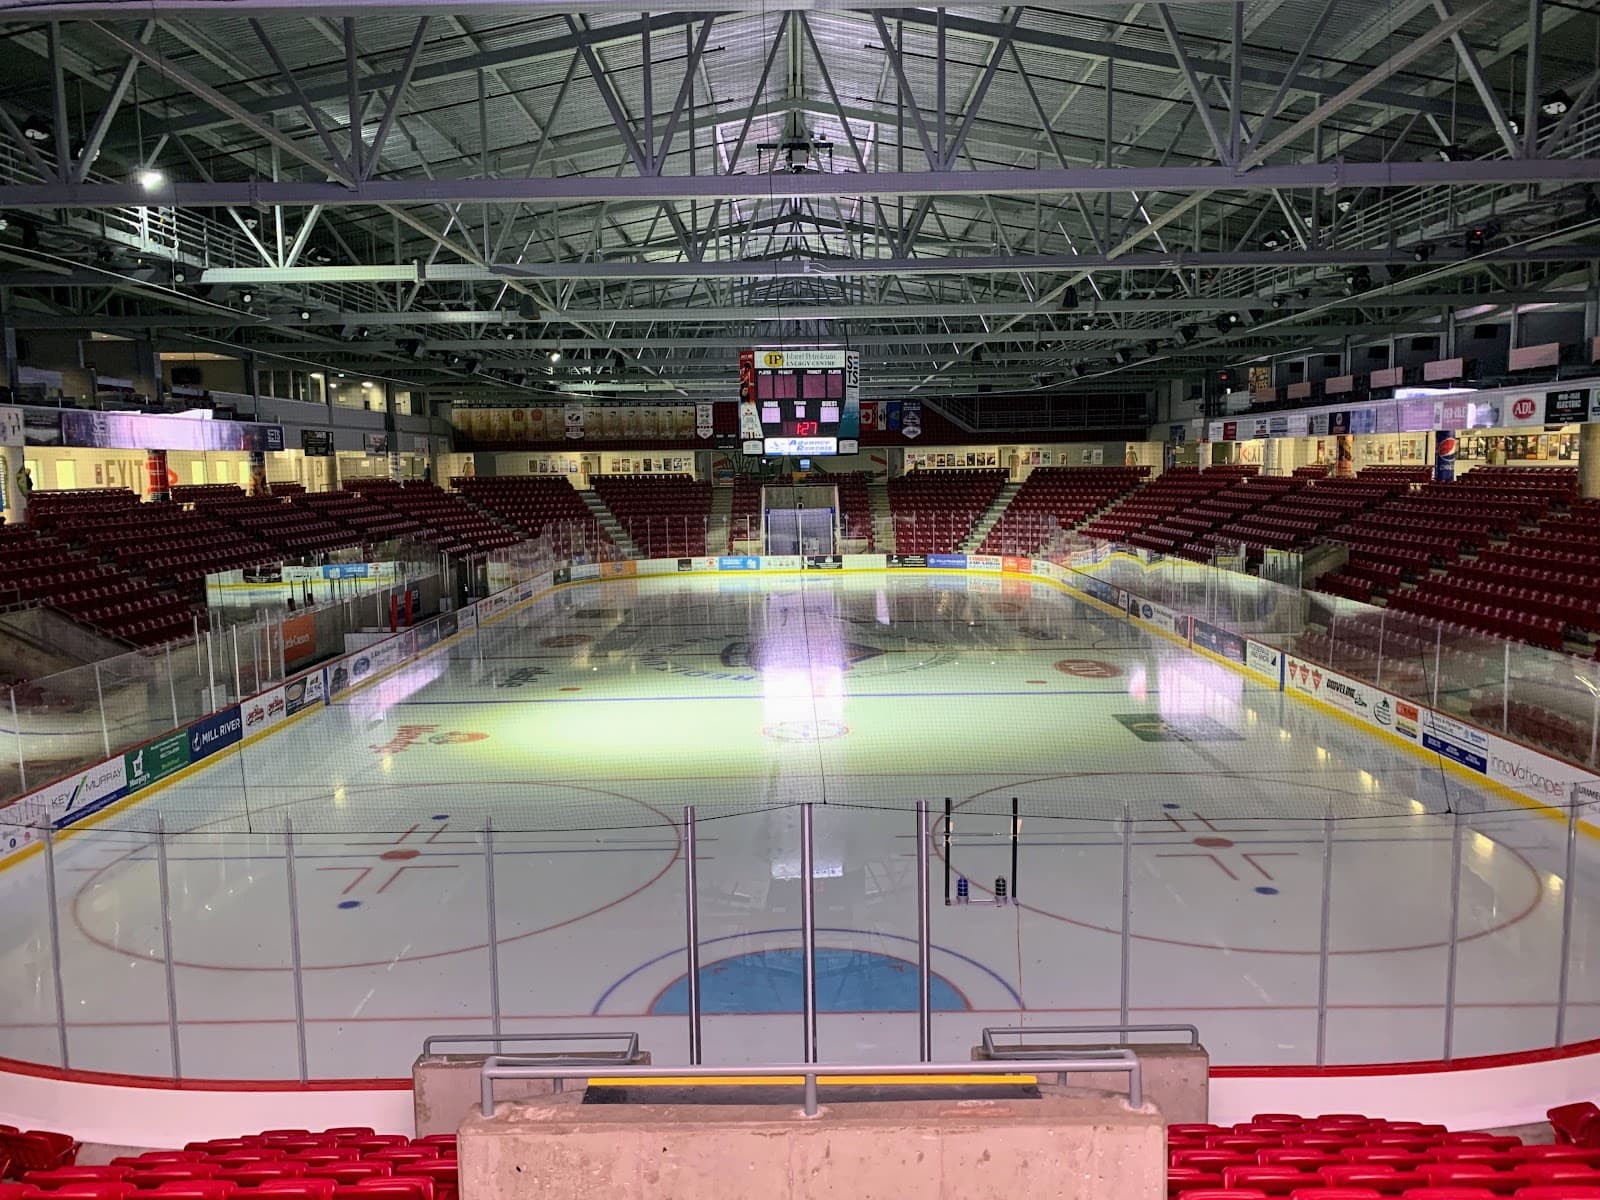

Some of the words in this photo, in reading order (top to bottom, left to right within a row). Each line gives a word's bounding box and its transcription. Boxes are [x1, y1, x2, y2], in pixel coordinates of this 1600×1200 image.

[768, 354, 782, 365] IP
[1514, 401, 1535, 415] ADL
[105, 459, 143, 494] EXIT
[201, 727, 219, 745] MILL
[219, 718, 241, 736] RIVER
[51, 792, 71, 808] KEY
[85, 768, 122, 792] MURRAY
